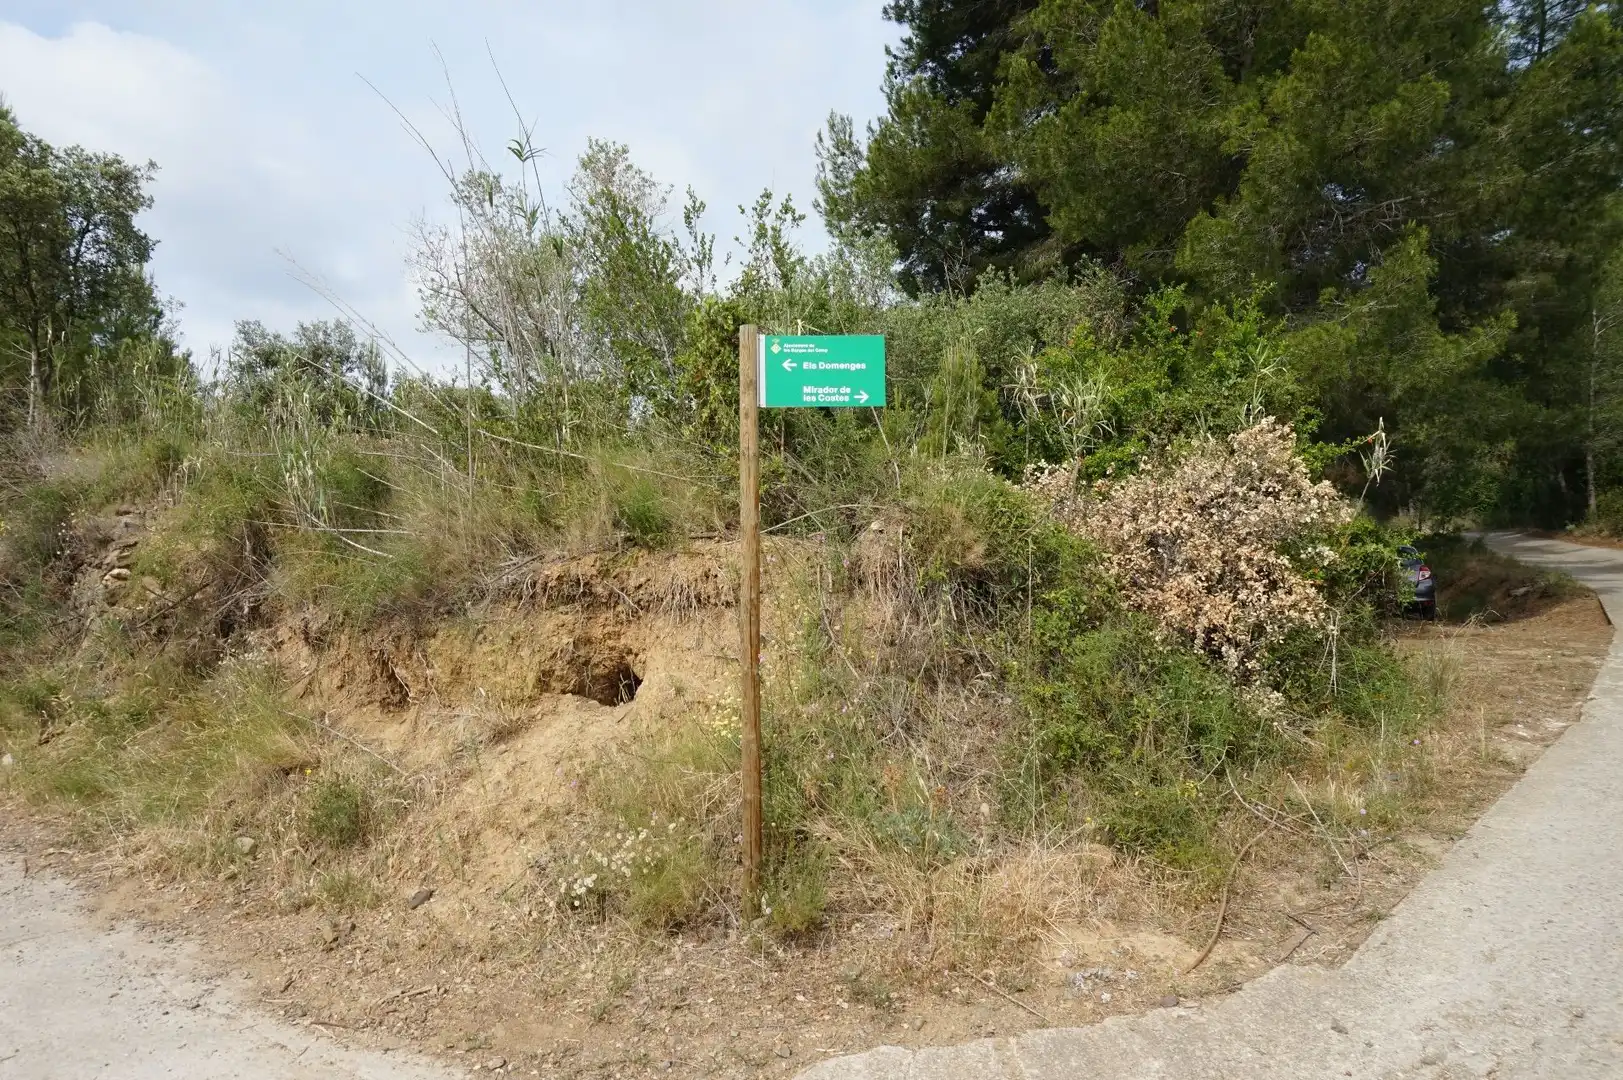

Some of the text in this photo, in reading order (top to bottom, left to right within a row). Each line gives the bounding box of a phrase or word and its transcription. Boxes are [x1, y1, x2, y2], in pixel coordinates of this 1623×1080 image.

[803, 362, 866, 371] Els Domenges
[803, 385, 851, 394] Mirador de
[803, 394, 850, 402] les Costes
